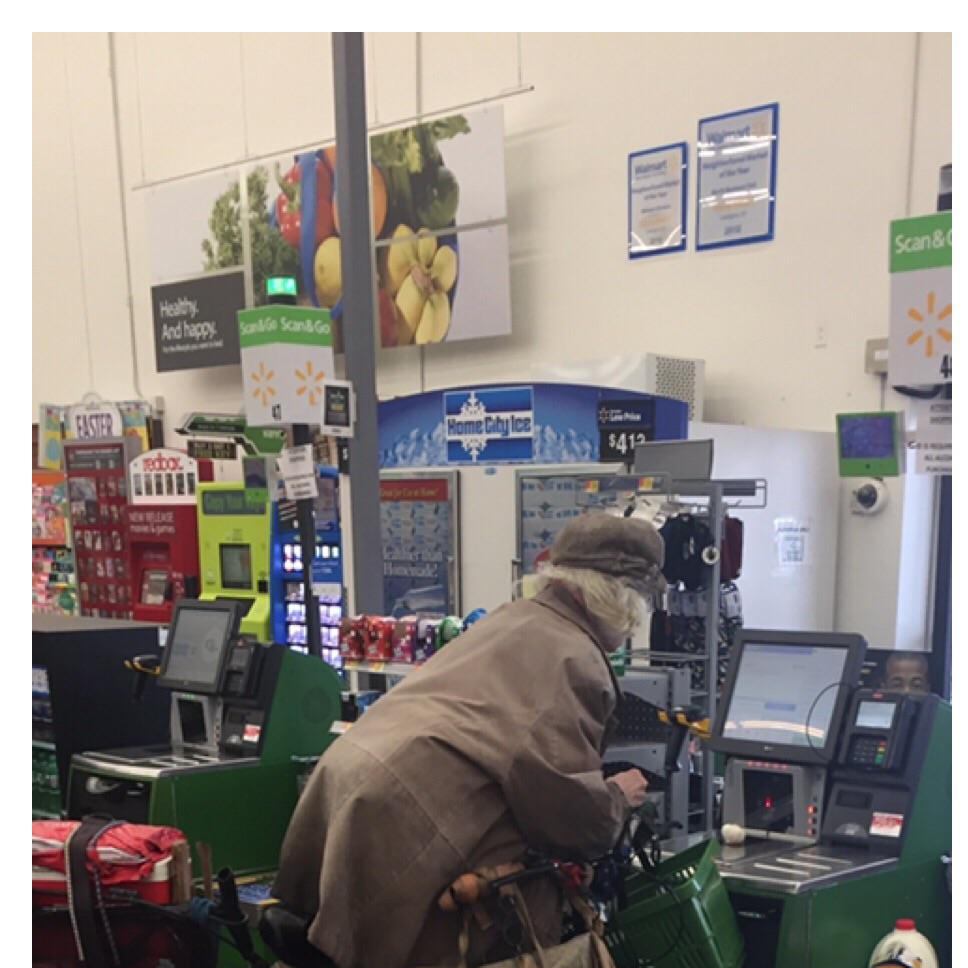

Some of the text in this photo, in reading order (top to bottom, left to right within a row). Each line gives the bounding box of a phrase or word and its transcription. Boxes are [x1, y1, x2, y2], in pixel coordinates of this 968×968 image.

[634, 160, 667, 175] Walmart
[159, 296, 199, 318] Healthy.
[162, 320, 218, 340] And happy.
[76, 413, 113, 440] EASTER
[447, 415, 531, 436] Home City Ice
[128, 511, 174, 522] NEW RELEASE
